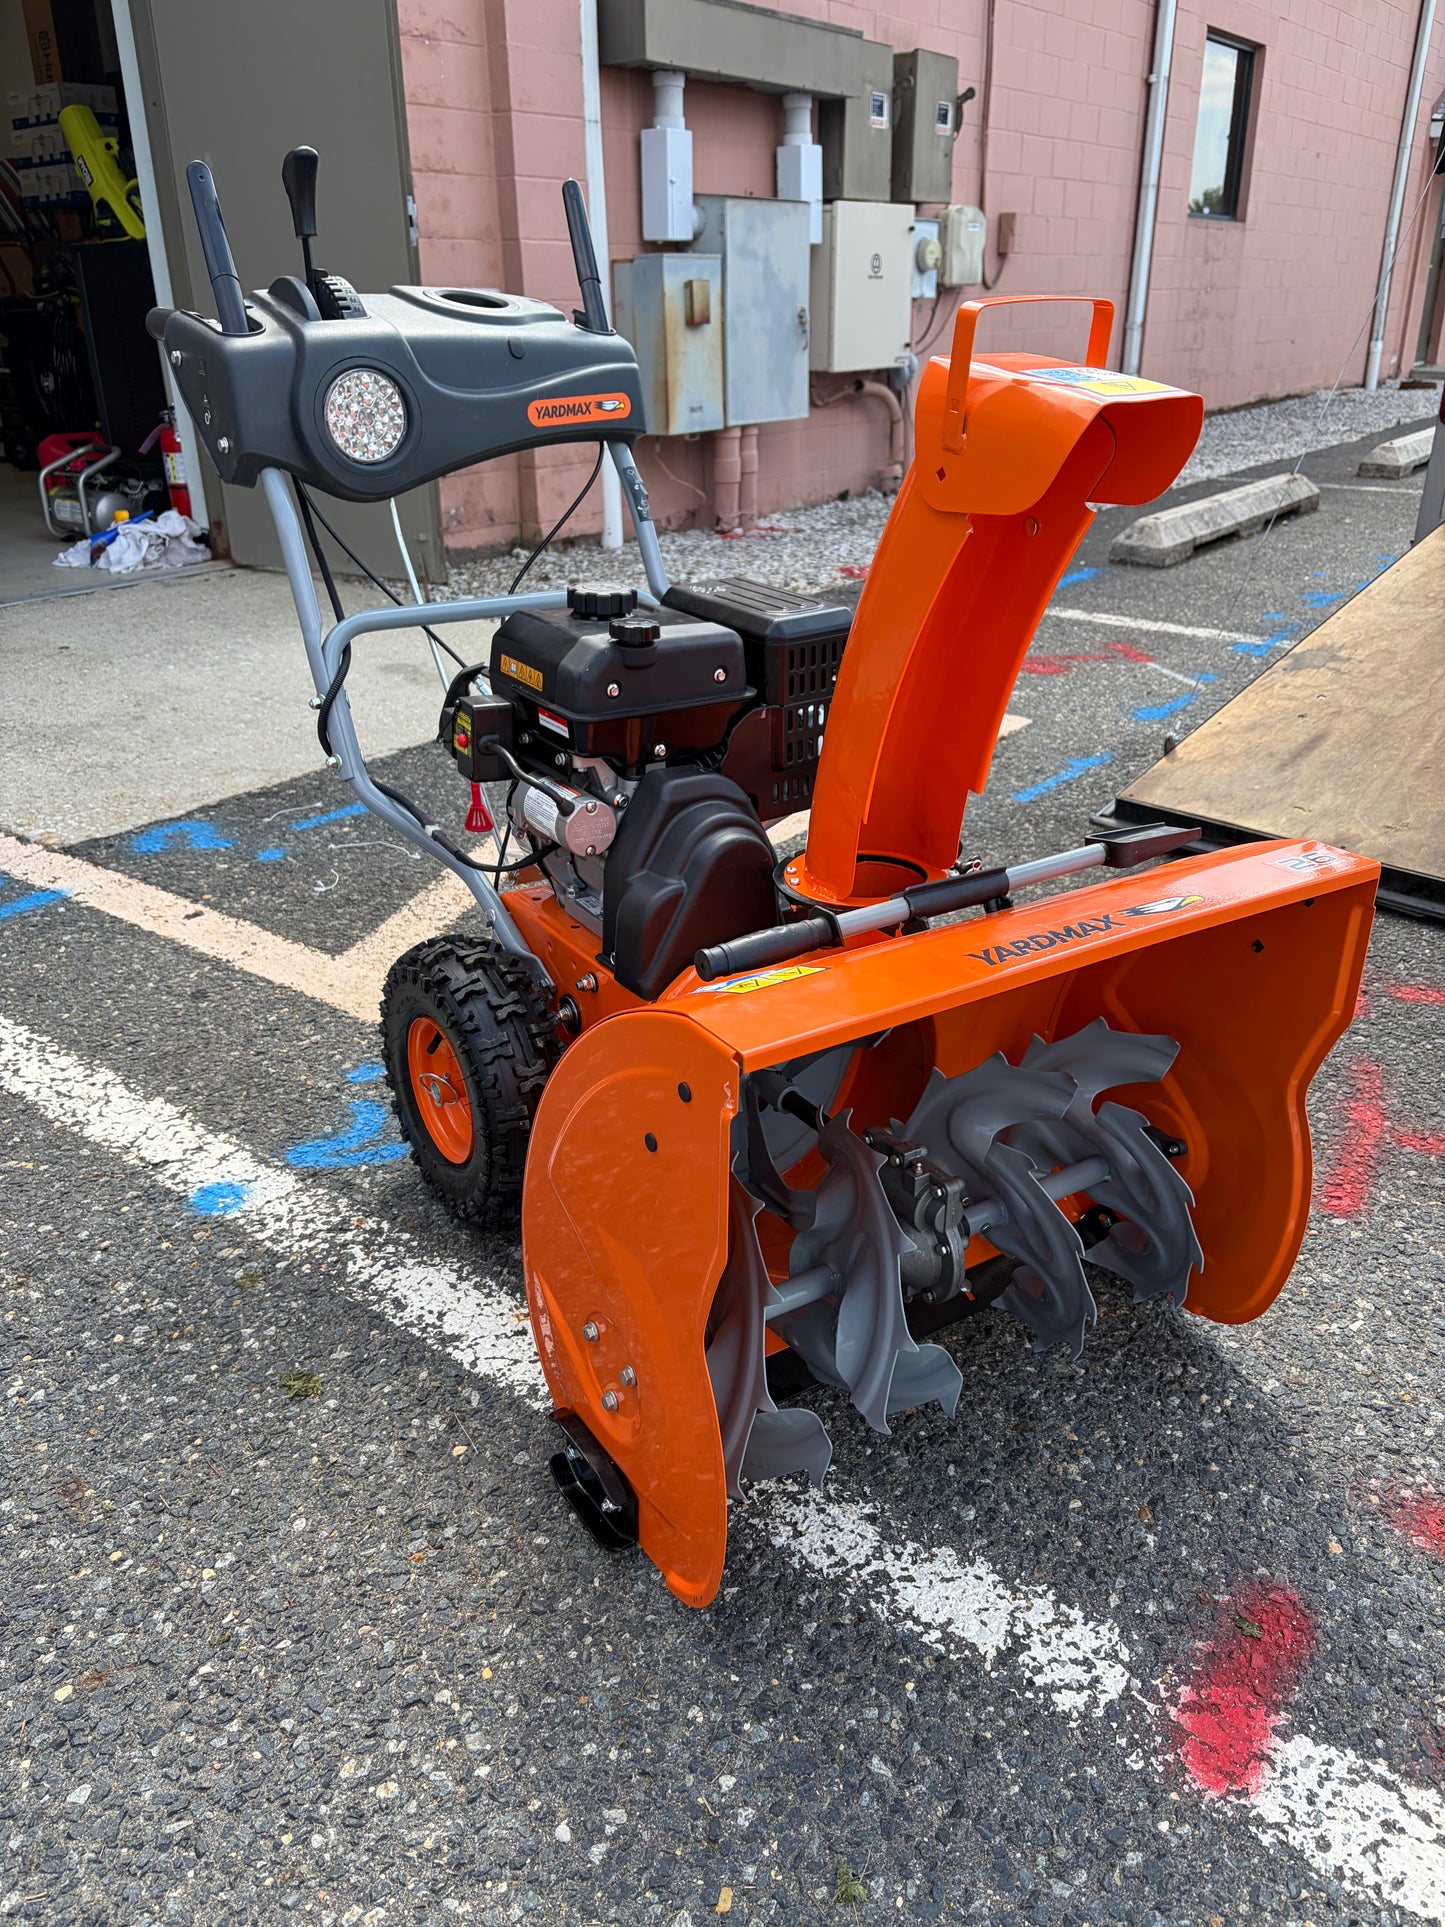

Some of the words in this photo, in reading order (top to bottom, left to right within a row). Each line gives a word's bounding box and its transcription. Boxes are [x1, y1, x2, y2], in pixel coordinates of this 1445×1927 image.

[77, 156, 92, 184] RYOBI
[535, 402, 592, 420] YARDMAX
[1277, 852, 1335, 870] 26
[966, 914, 1126, 966] YARDMAX
